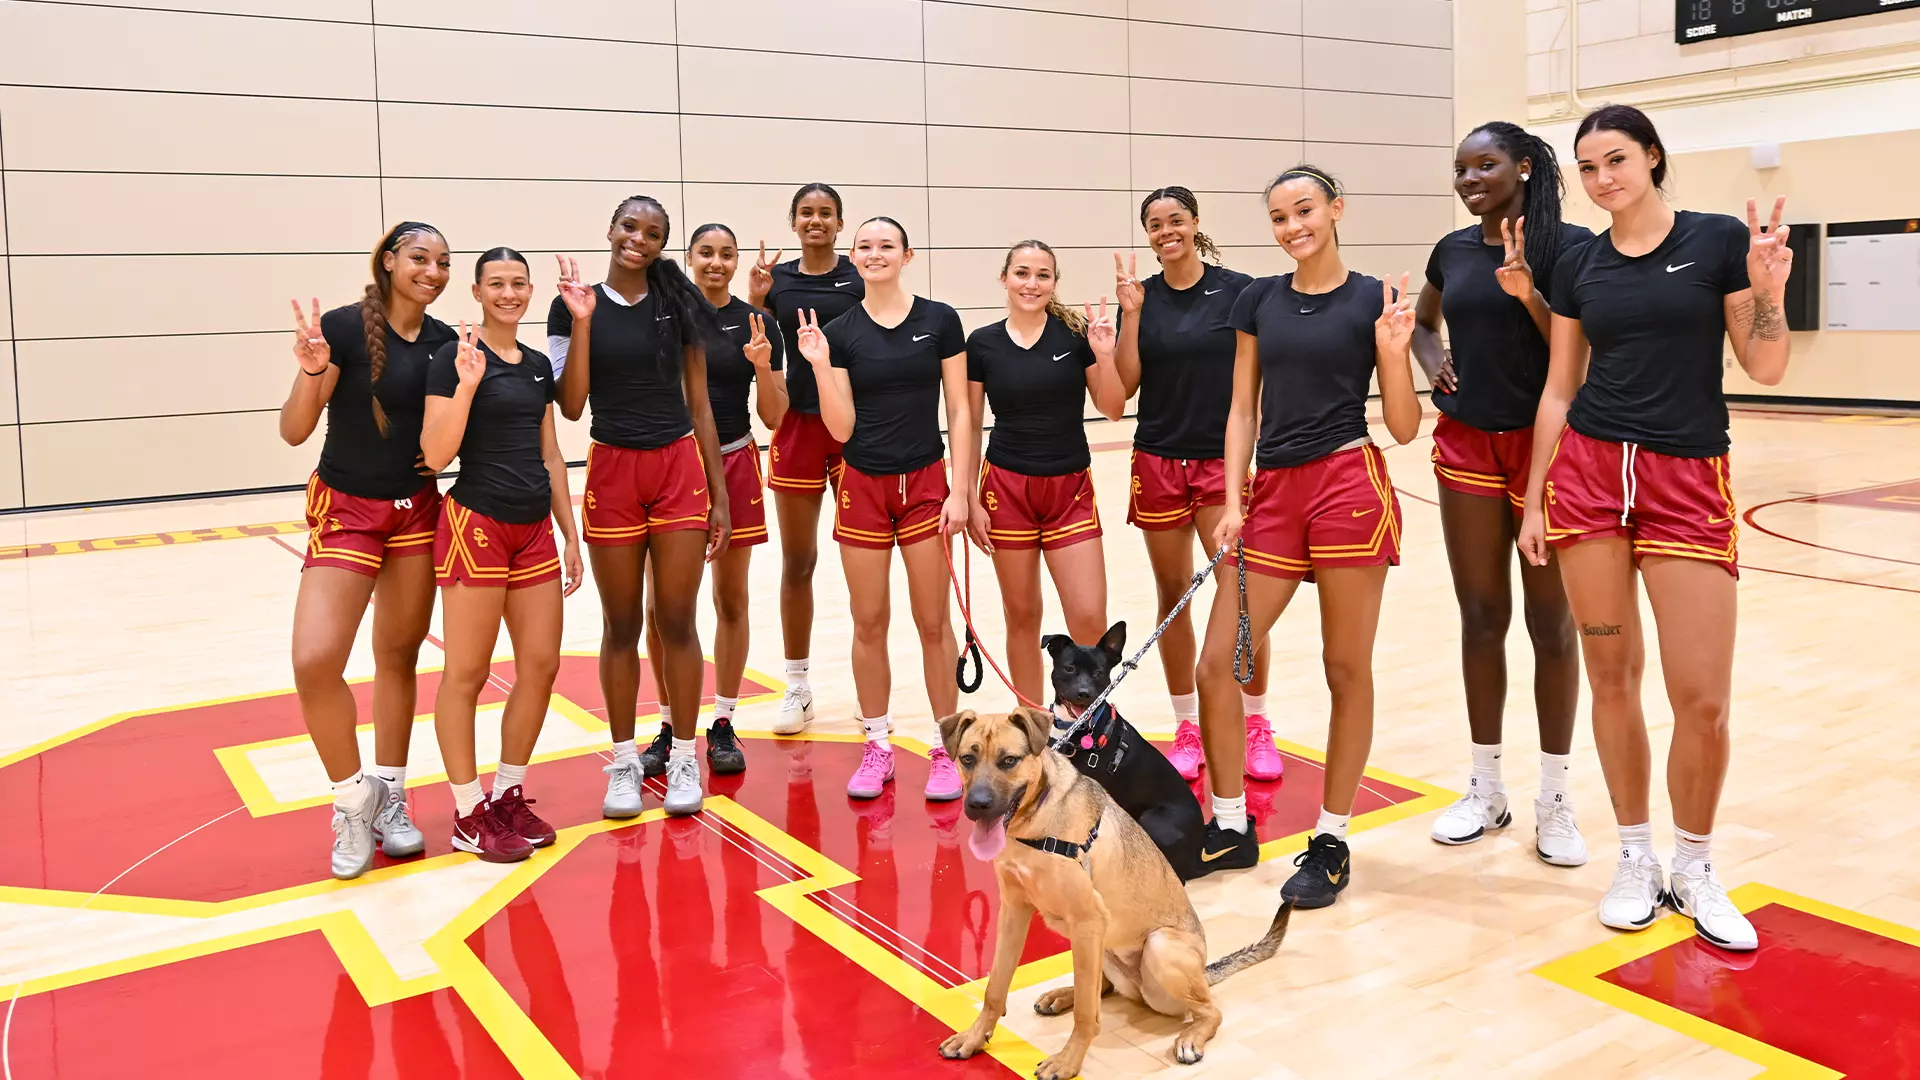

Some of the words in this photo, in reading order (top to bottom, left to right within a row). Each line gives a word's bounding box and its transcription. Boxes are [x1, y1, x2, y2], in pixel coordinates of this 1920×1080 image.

[1776, 8, 1813, 22] MATCH
[1686, 24, 1717, 38] SCORE
[1132, 475, 1142, 495] SC
[587, 490, 597, 509] SC
[841, 490, 851, 509] SC
[986, 491, 998, 511] SC
[473, 527, 488, 547] SC
